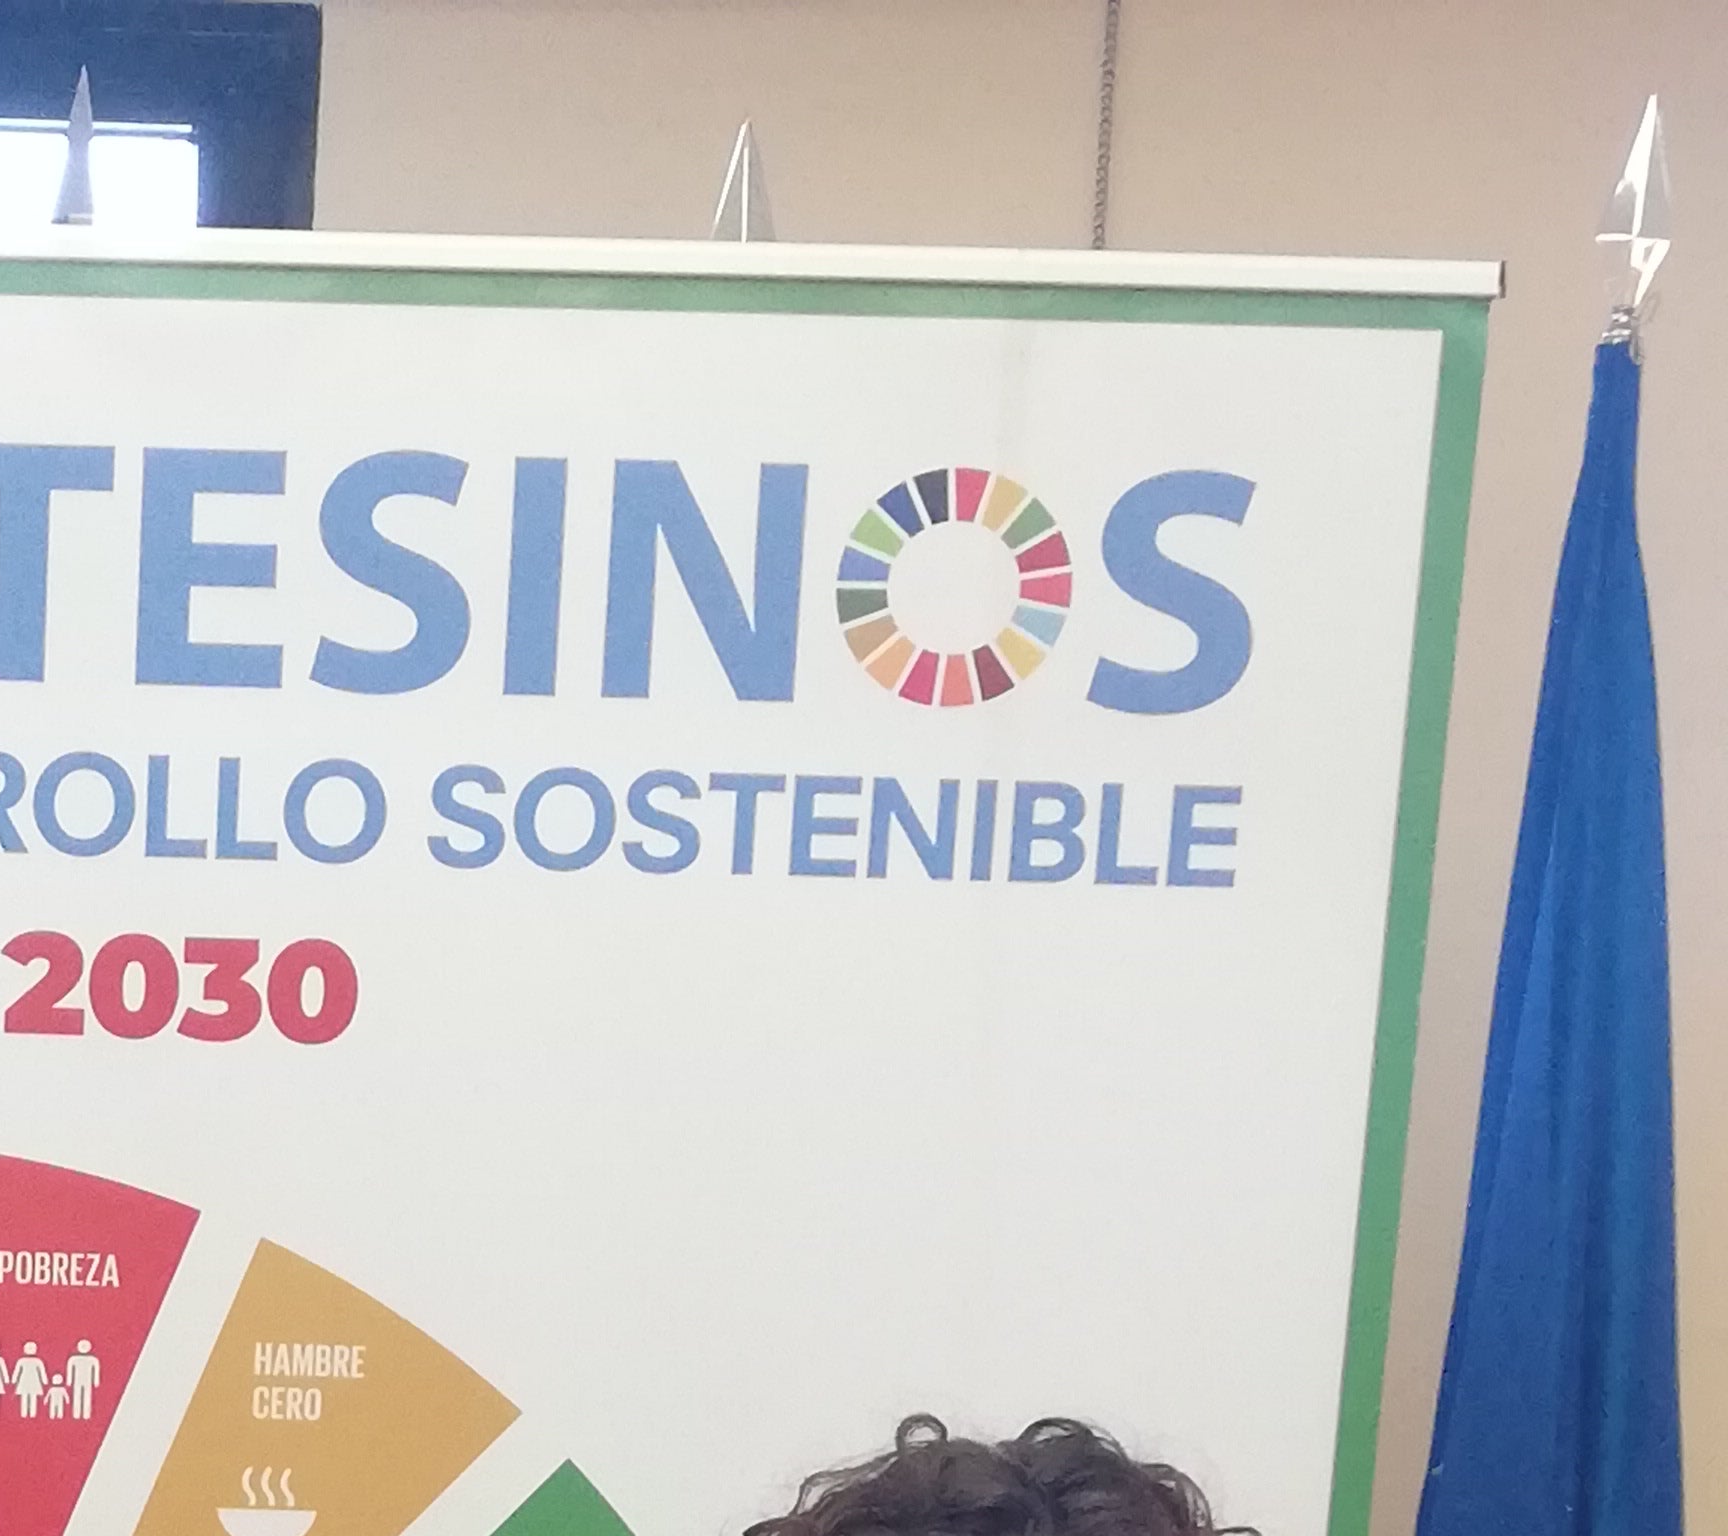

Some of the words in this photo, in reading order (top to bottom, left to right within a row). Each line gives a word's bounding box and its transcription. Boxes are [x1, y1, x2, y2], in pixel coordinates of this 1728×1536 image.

[427, 764, 1244, 889] SOSTENIBLE
[3, 930, 358, 1045] 2030
[254, 1342, 366, 1380] HAMBRE
[252, 1386, 322, 1421] CERO
